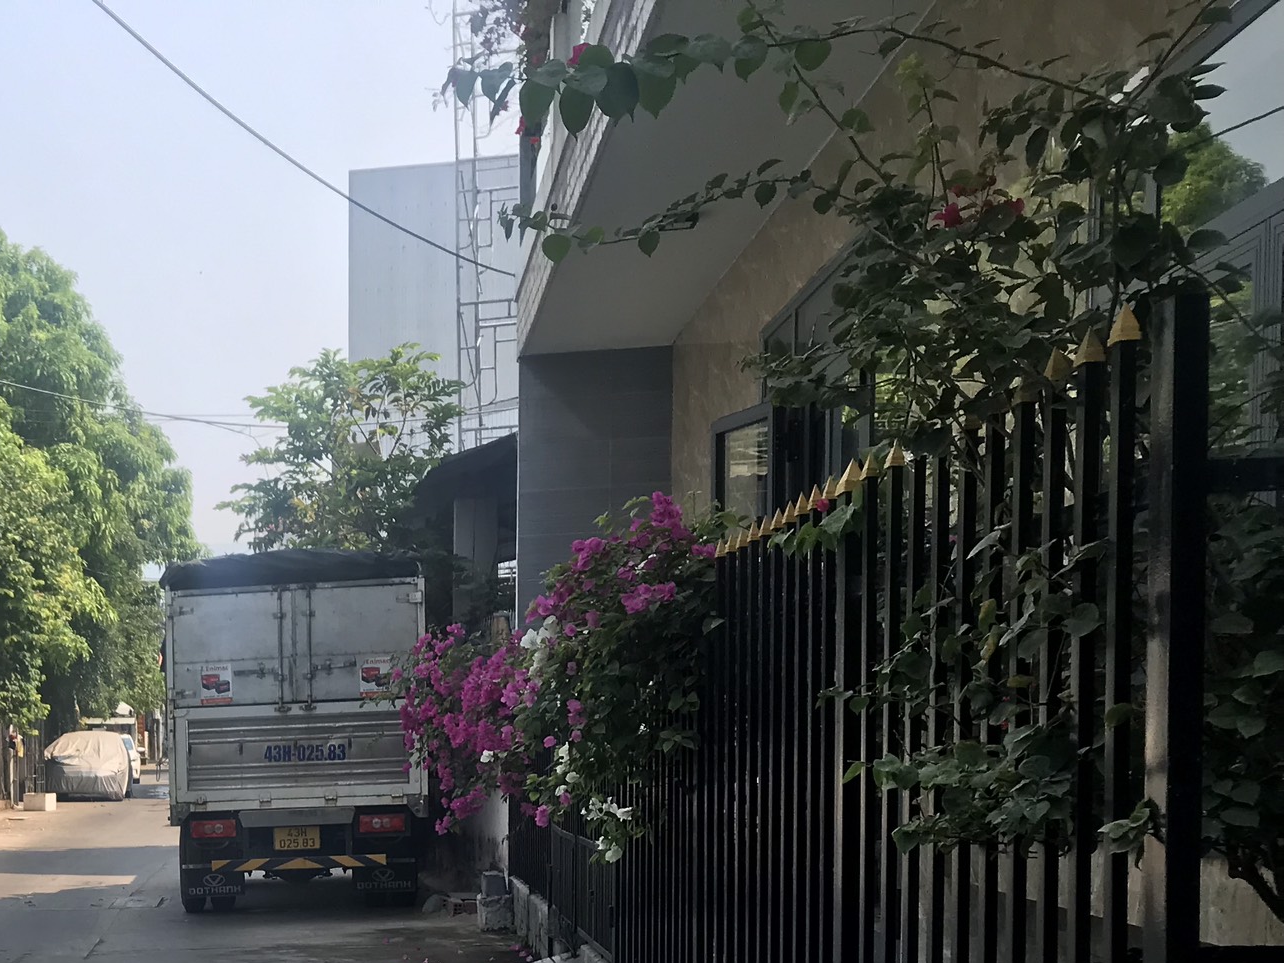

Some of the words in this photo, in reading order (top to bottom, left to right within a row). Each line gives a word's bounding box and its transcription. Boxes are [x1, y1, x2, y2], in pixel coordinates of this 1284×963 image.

[263, 742, 347, 763] 43H-025.83
[287, 827, 308, 838] 43H
[279, 837, 316, 849] 025.83
